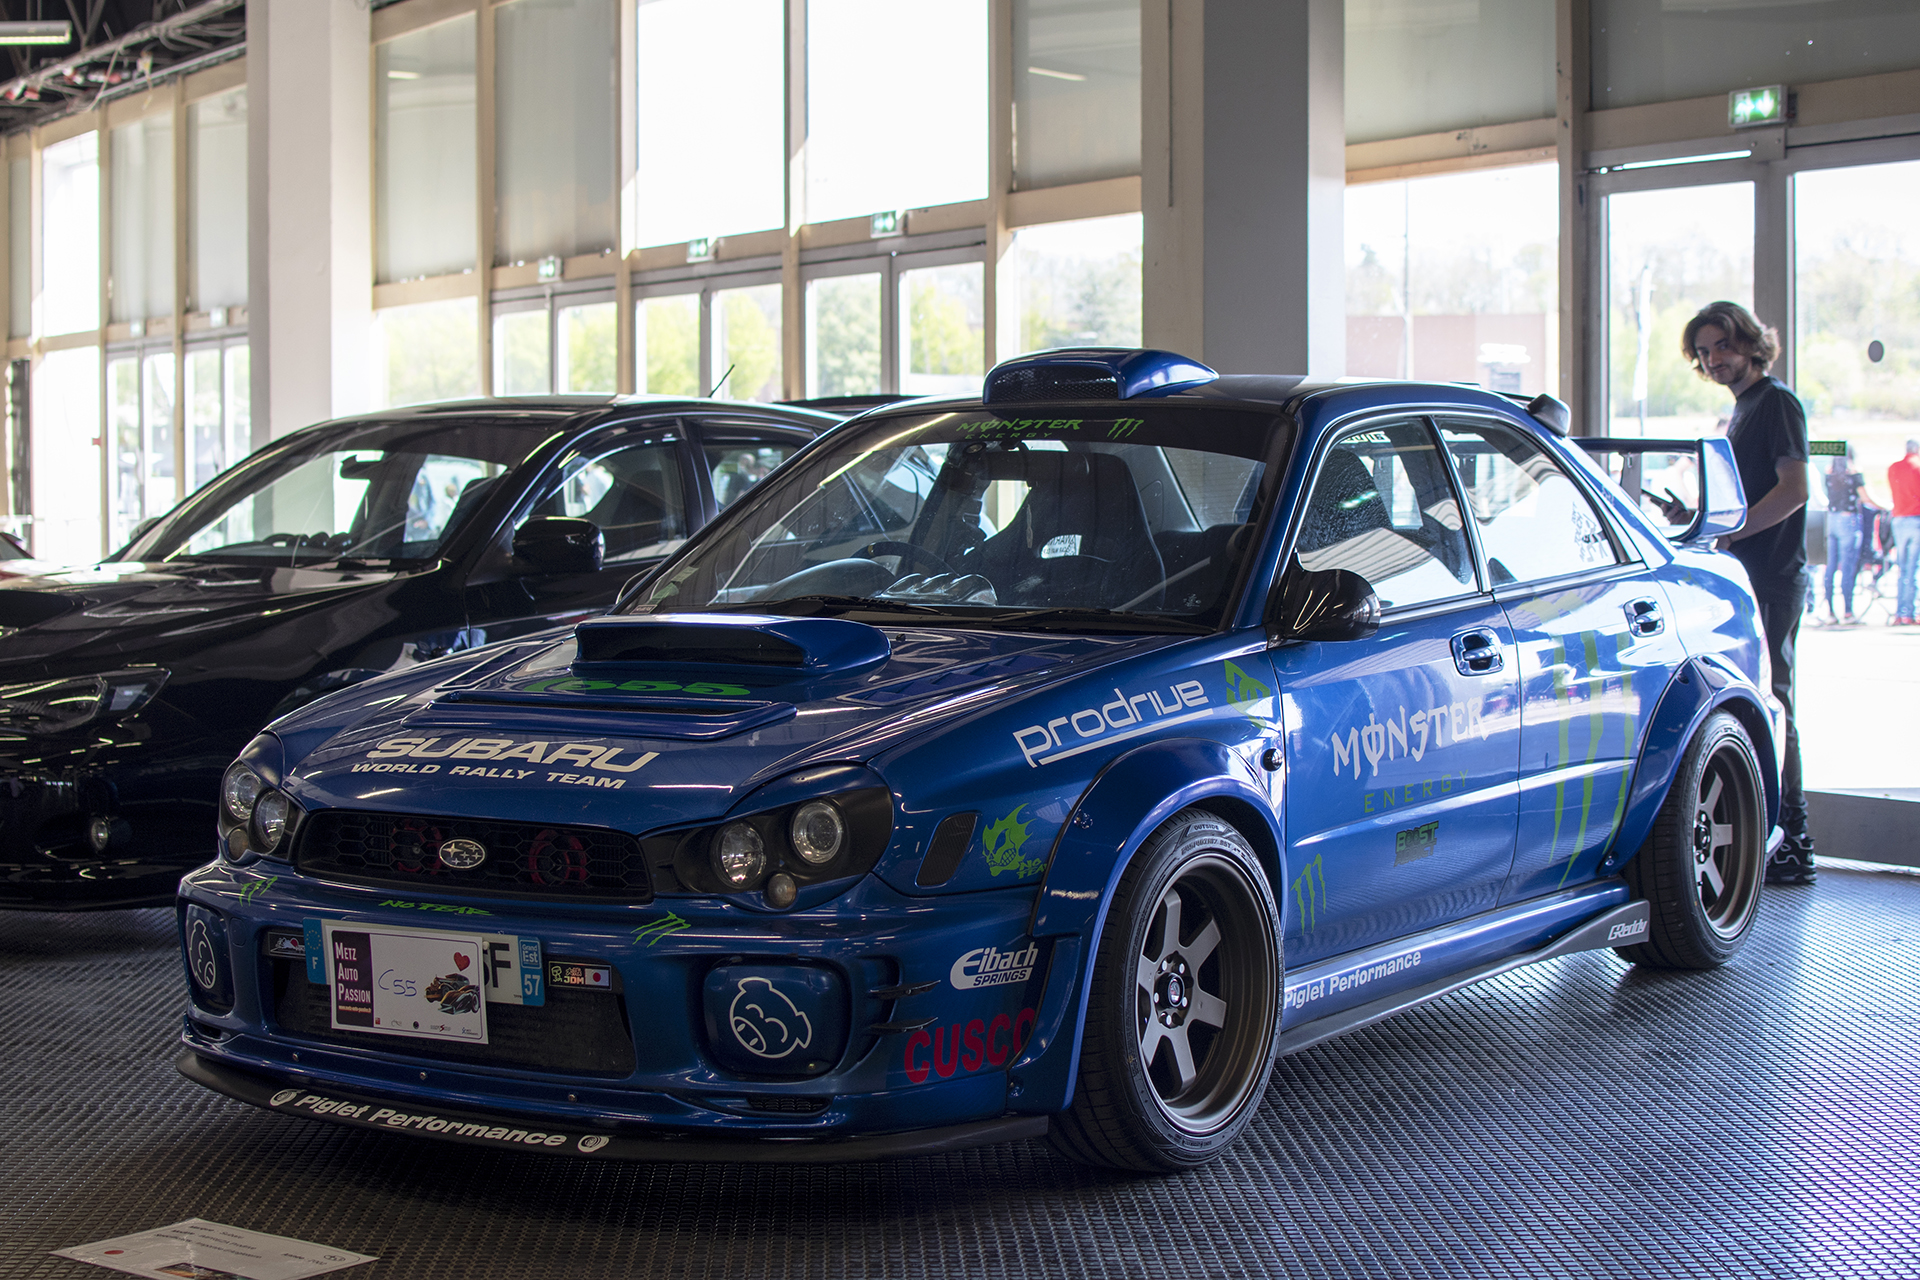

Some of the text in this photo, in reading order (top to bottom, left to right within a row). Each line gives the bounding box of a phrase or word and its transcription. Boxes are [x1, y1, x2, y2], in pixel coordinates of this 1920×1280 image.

[1810, 442, 1845, 454] OUSSEZ
[1013, 680, 1209, 768] prodrive
[366, 737, 660, 773] SUBARU
[351, 763, 626, 789] WORLD RALLY TEAM
[1364, 769, 1469, 813] ENERGY
[418, 903, 495, 916] FEAR
[522, 943, 538, 951] Grand
[522, 951, 538, 963] Est
[312, 957, 318, 970] F
[950, 942, 1039, 981] Eibach
[524, 974, 540, 996] 57
[563, 976, 585, 985] JDM
[973, 970, 1027, 987] SPRINGS
[1284, 951, 1422, 1009] Piglet Performance
[295, 1094, 568, 1147] Piglet Performance
